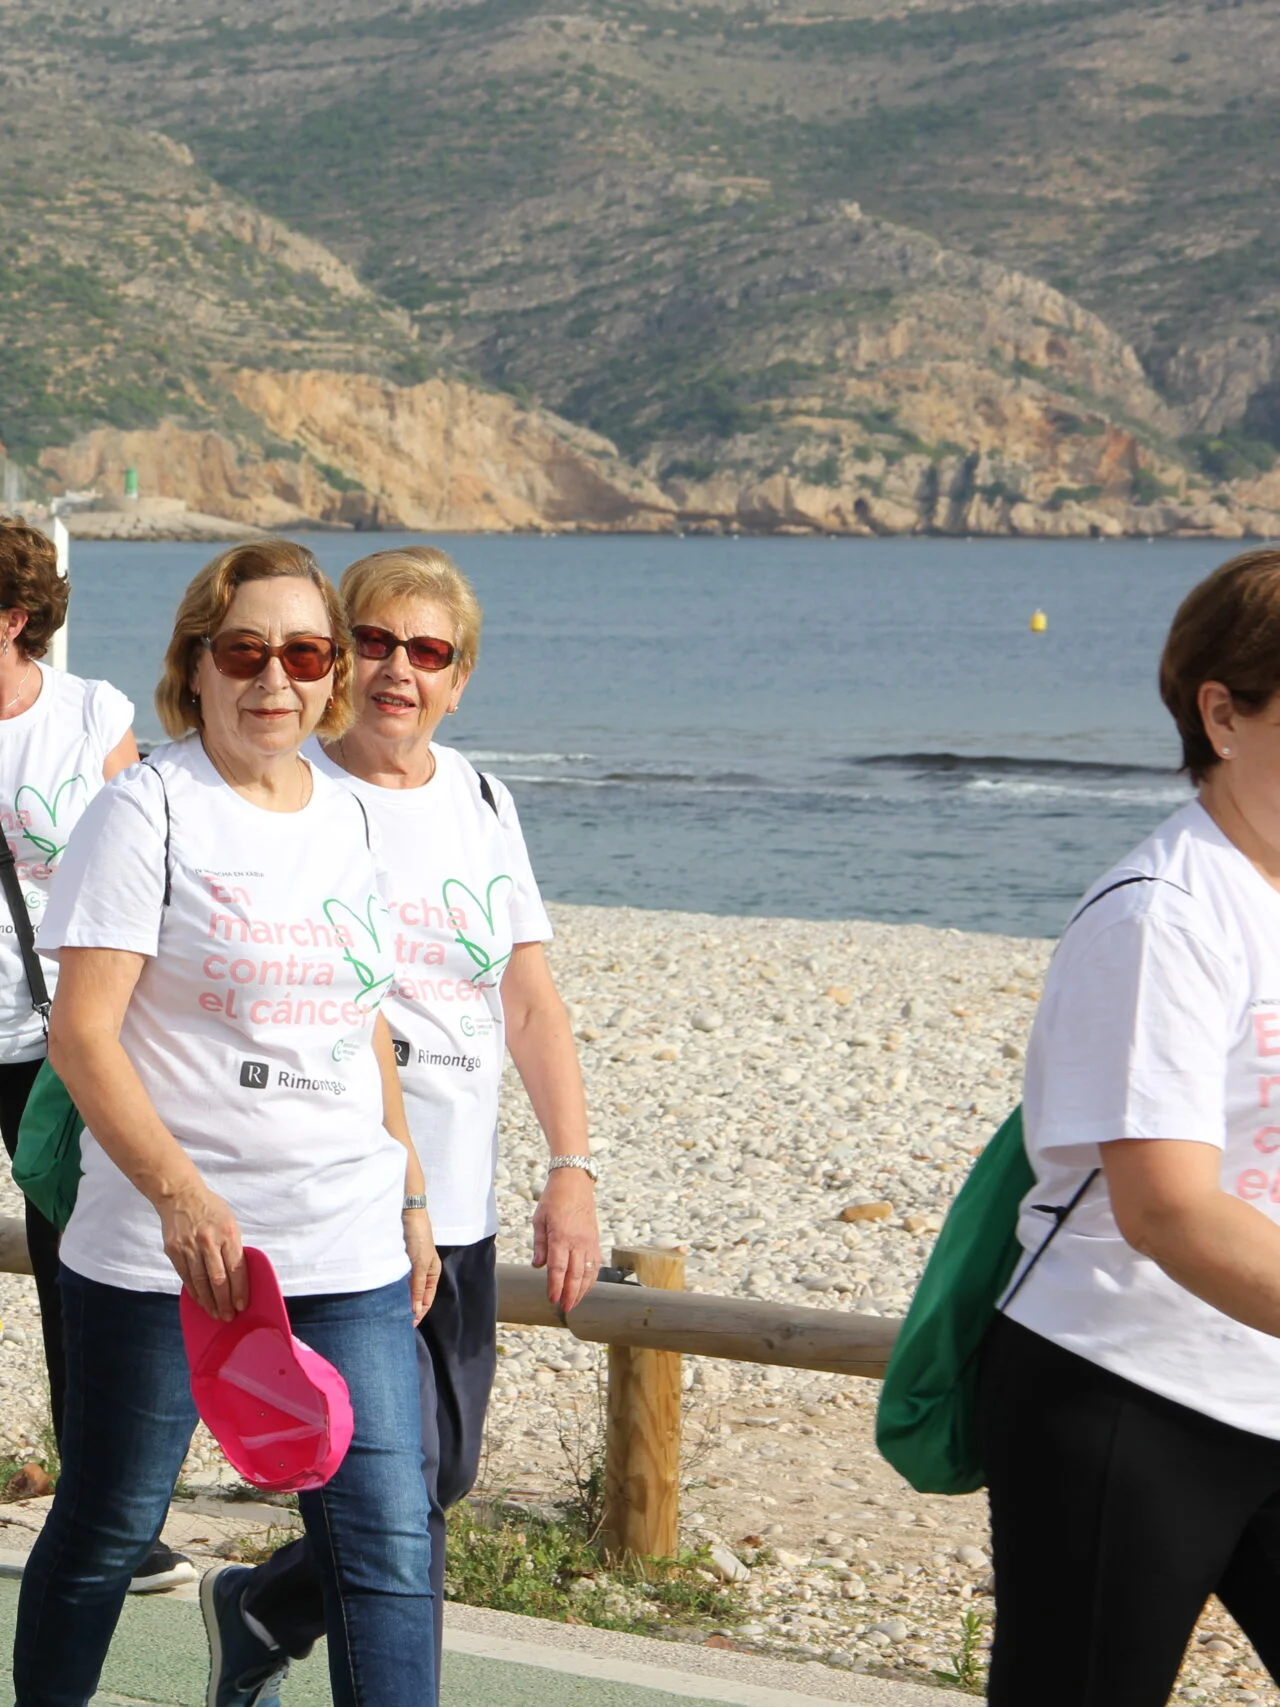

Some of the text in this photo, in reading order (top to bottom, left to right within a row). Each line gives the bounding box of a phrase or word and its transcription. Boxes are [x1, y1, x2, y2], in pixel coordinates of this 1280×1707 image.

[208, 913, 355, 949] marcha
[202, 953, 335, 986] contra
[198, 988, 373, 1026] el cáncer
